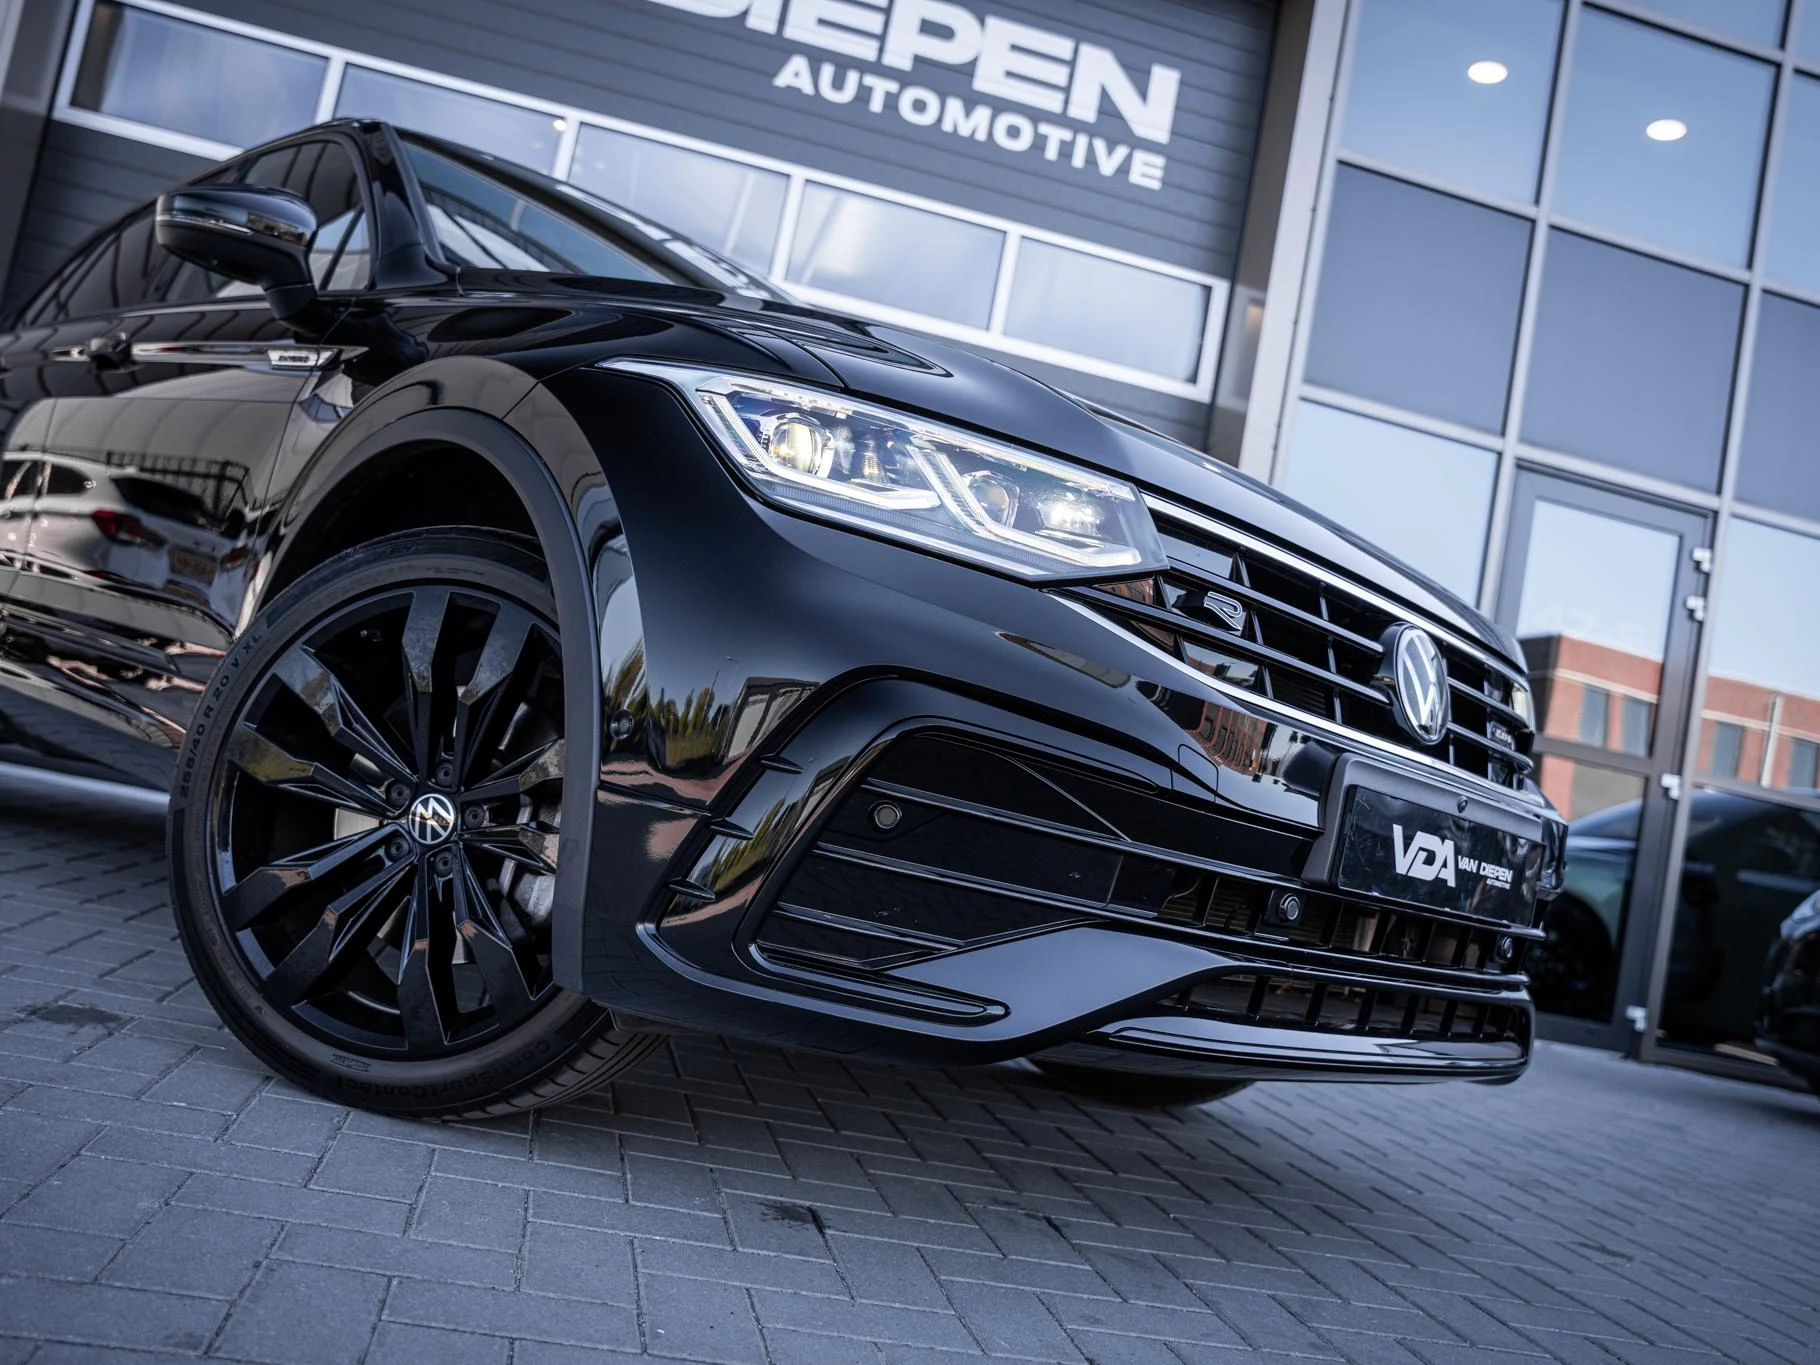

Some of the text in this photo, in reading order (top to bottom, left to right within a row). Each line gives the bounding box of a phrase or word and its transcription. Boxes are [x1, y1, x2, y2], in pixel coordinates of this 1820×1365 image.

[645, 0, 1181, 144] EPEN
[772, 54, 1168, 190] AUTOMOTIVE
[204, 704, 215, 719] R
[213, 674, 230, 702] 20
[243, 633, 263, 655] XL
[1392, 823, 1456, 888] VDA
[1457, 855, 1514, 883] VAN DIEPEN
